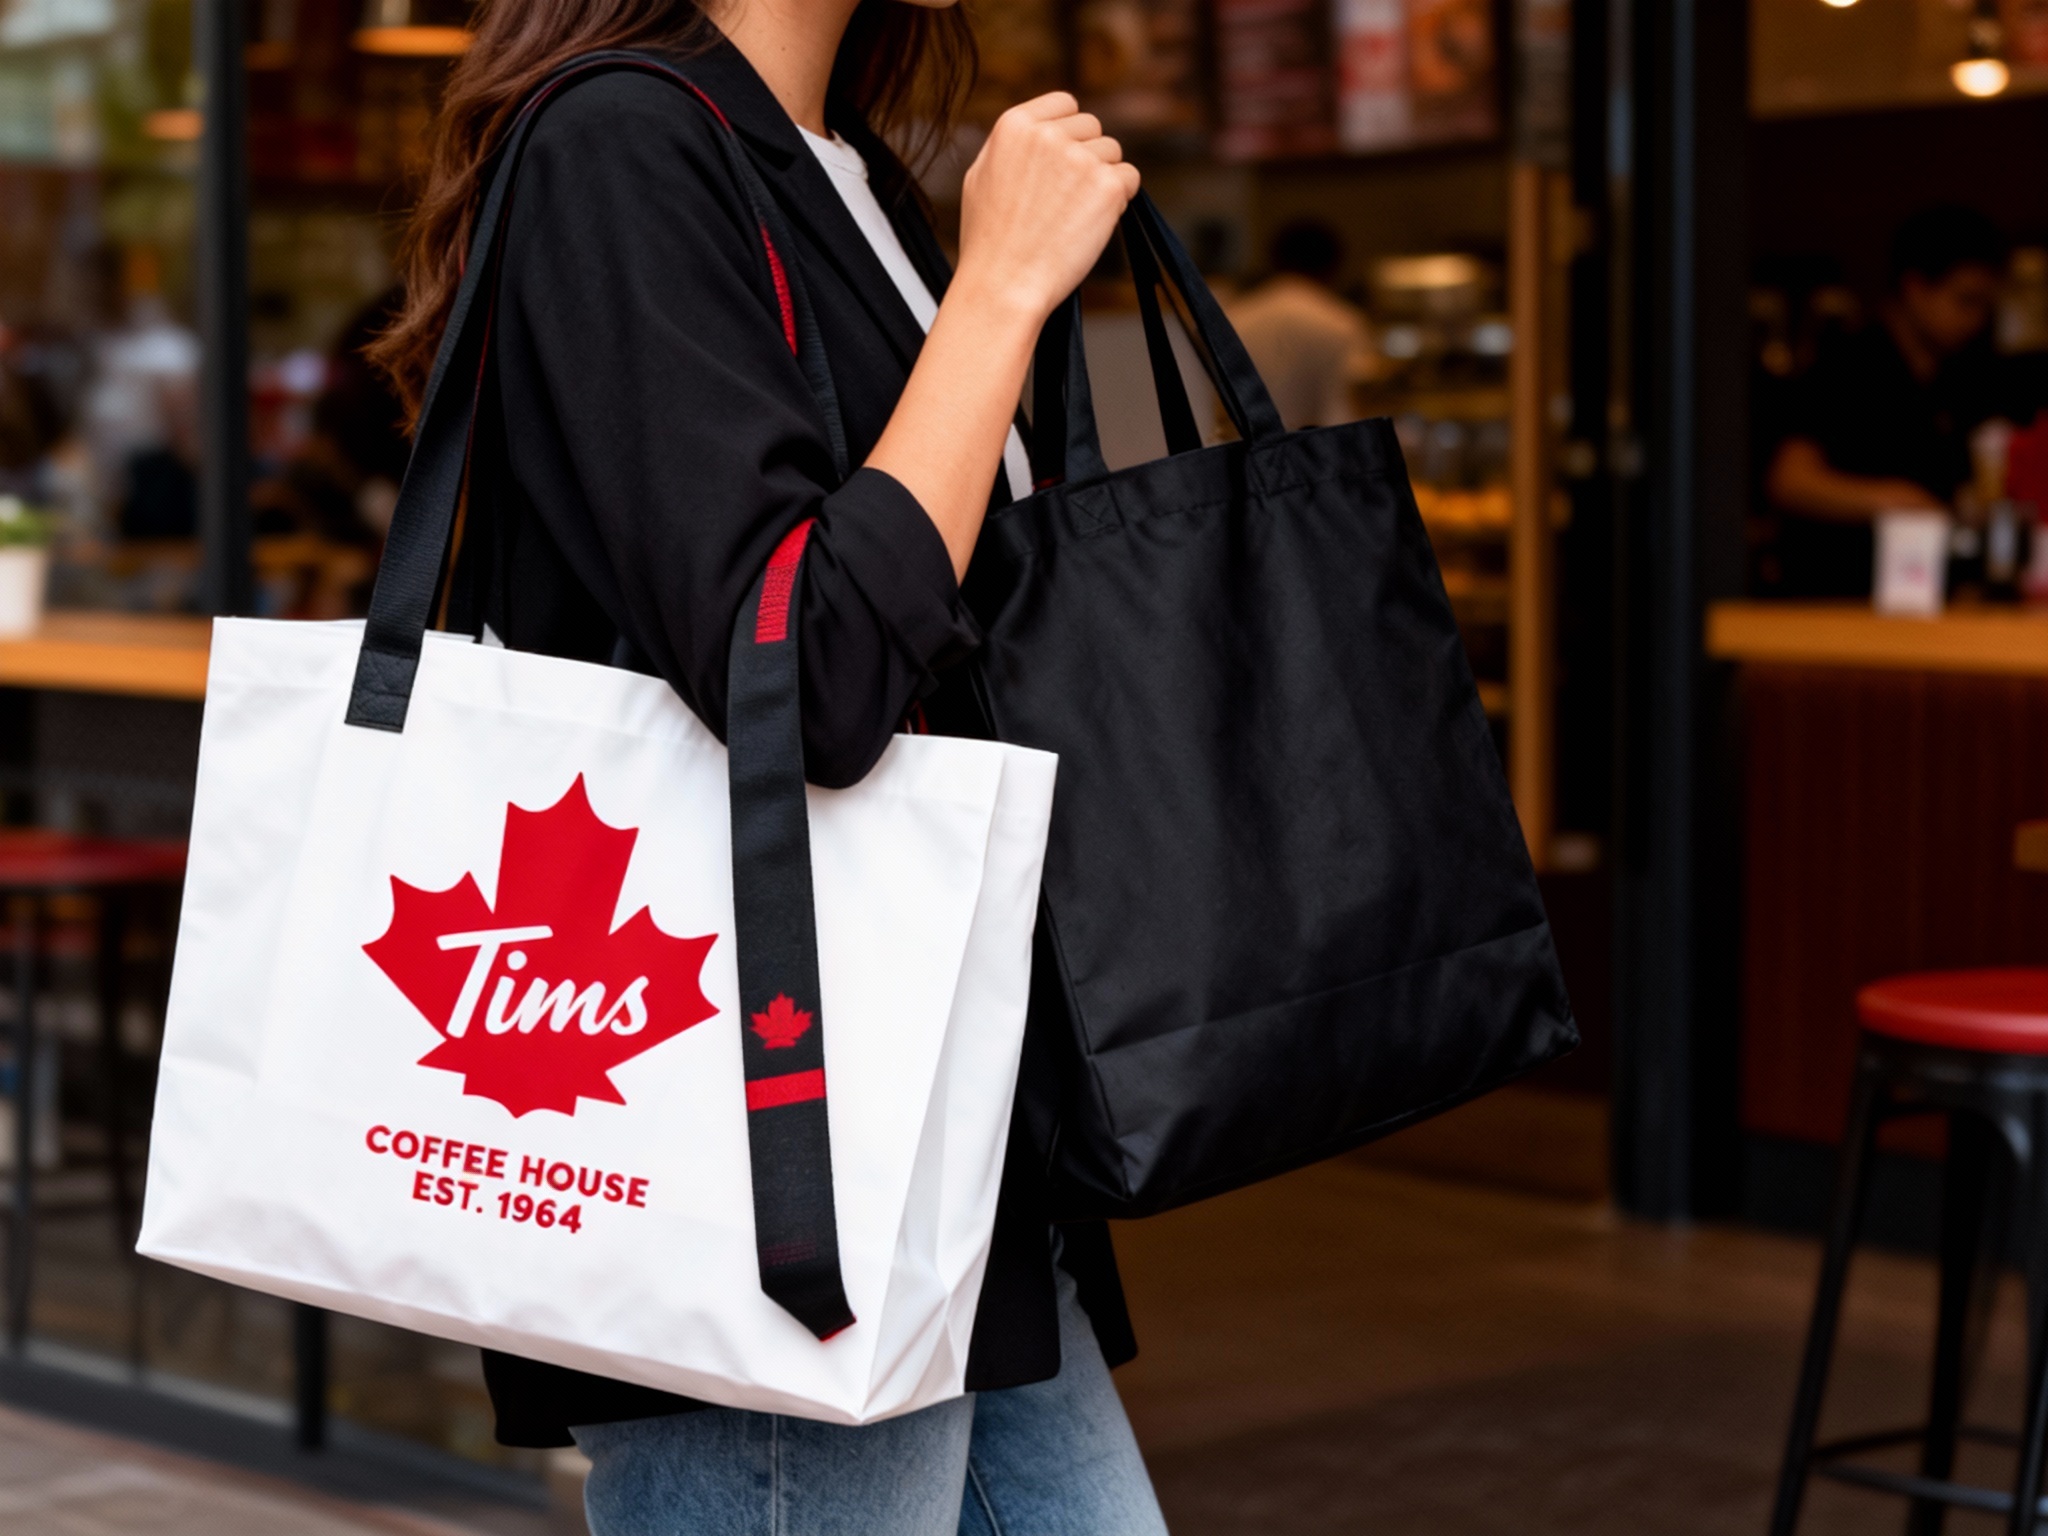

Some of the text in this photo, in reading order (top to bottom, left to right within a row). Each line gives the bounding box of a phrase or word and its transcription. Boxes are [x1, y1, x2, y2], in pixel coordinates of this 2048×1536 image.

[437, 925, 650, 1038] Tims
[365, 1124, 651, 1209] COFFEE HOUSE
[411, 1170, 582, 1235] EST. 1964
